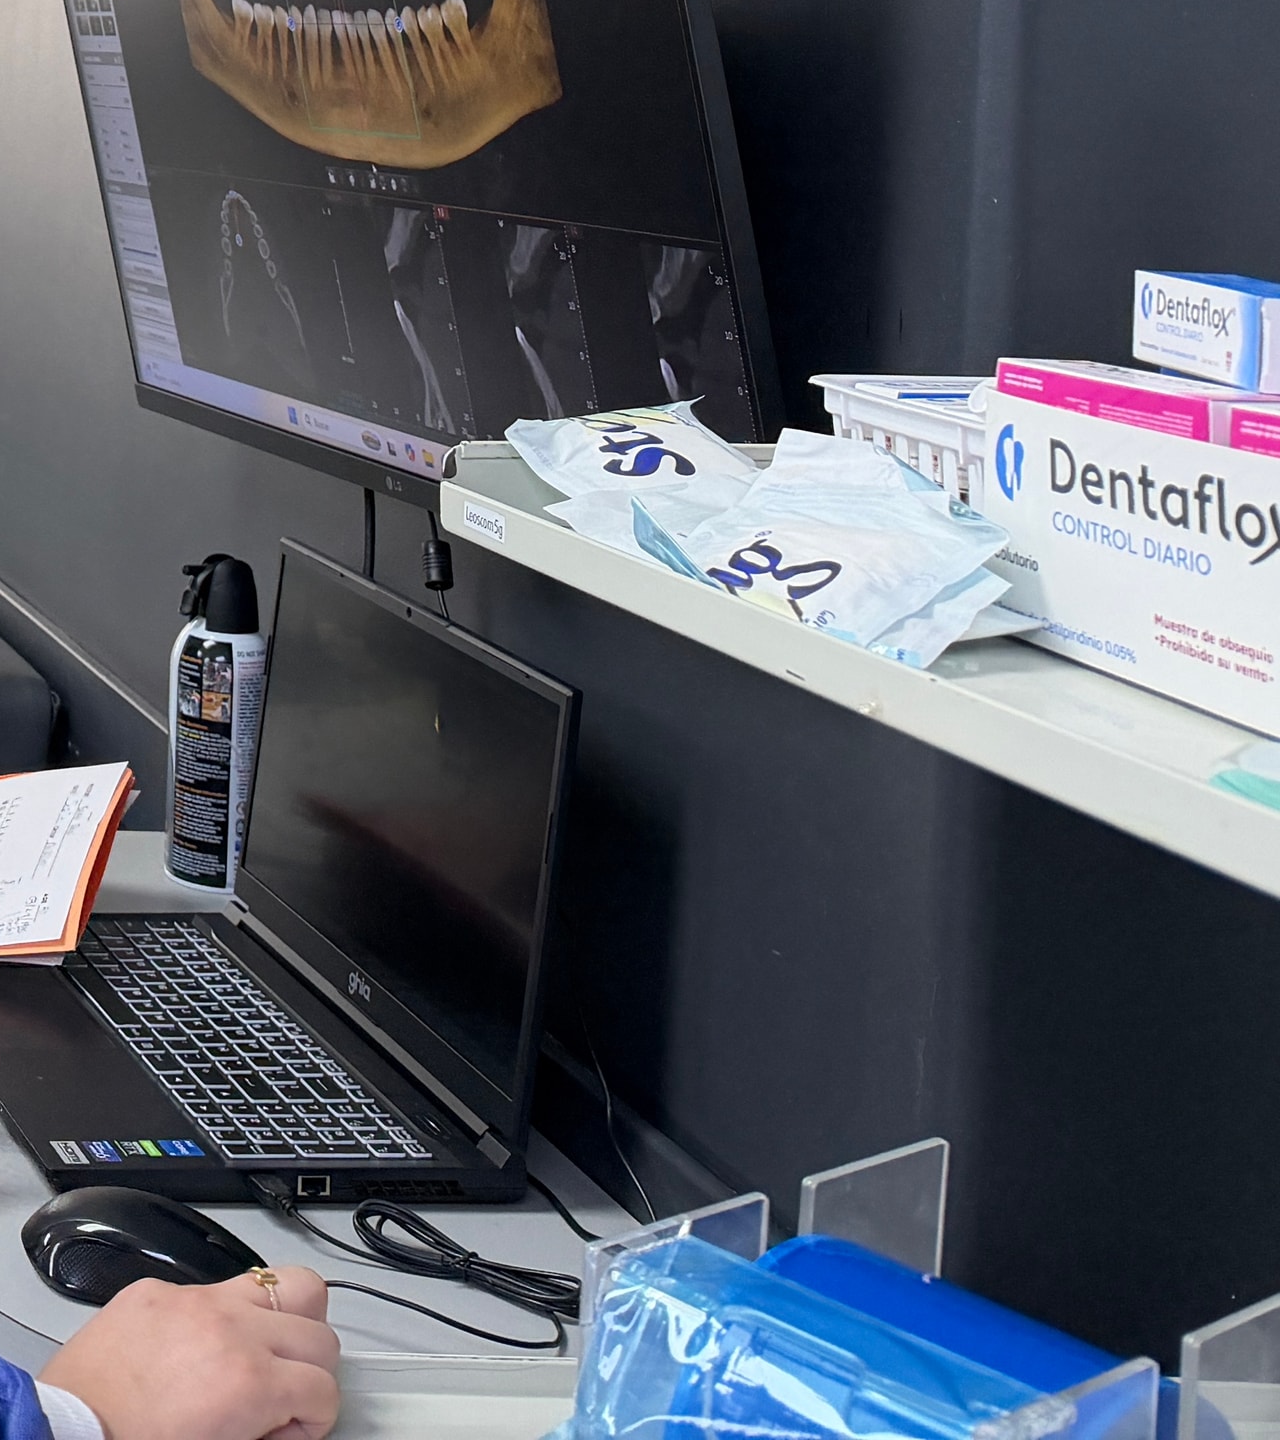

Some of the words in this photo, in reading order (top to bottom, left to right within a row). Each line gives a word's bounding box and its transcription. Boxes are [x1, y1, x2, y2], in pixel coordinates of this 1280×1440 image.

[1156, 288, 1233, 337] Dentaflox
[1052, 510, 1139, 556] CONTROL
[1144, 537, 1213, 576] DIARIO
[1104, 637, 1138, 665] 0.05%
[1201, 629, 1216, 646] de
[1219, 635, 1274, 665] obsequio
[1217, 655, 1232, 670] su
[349, 971, 371, 1002] ghia
